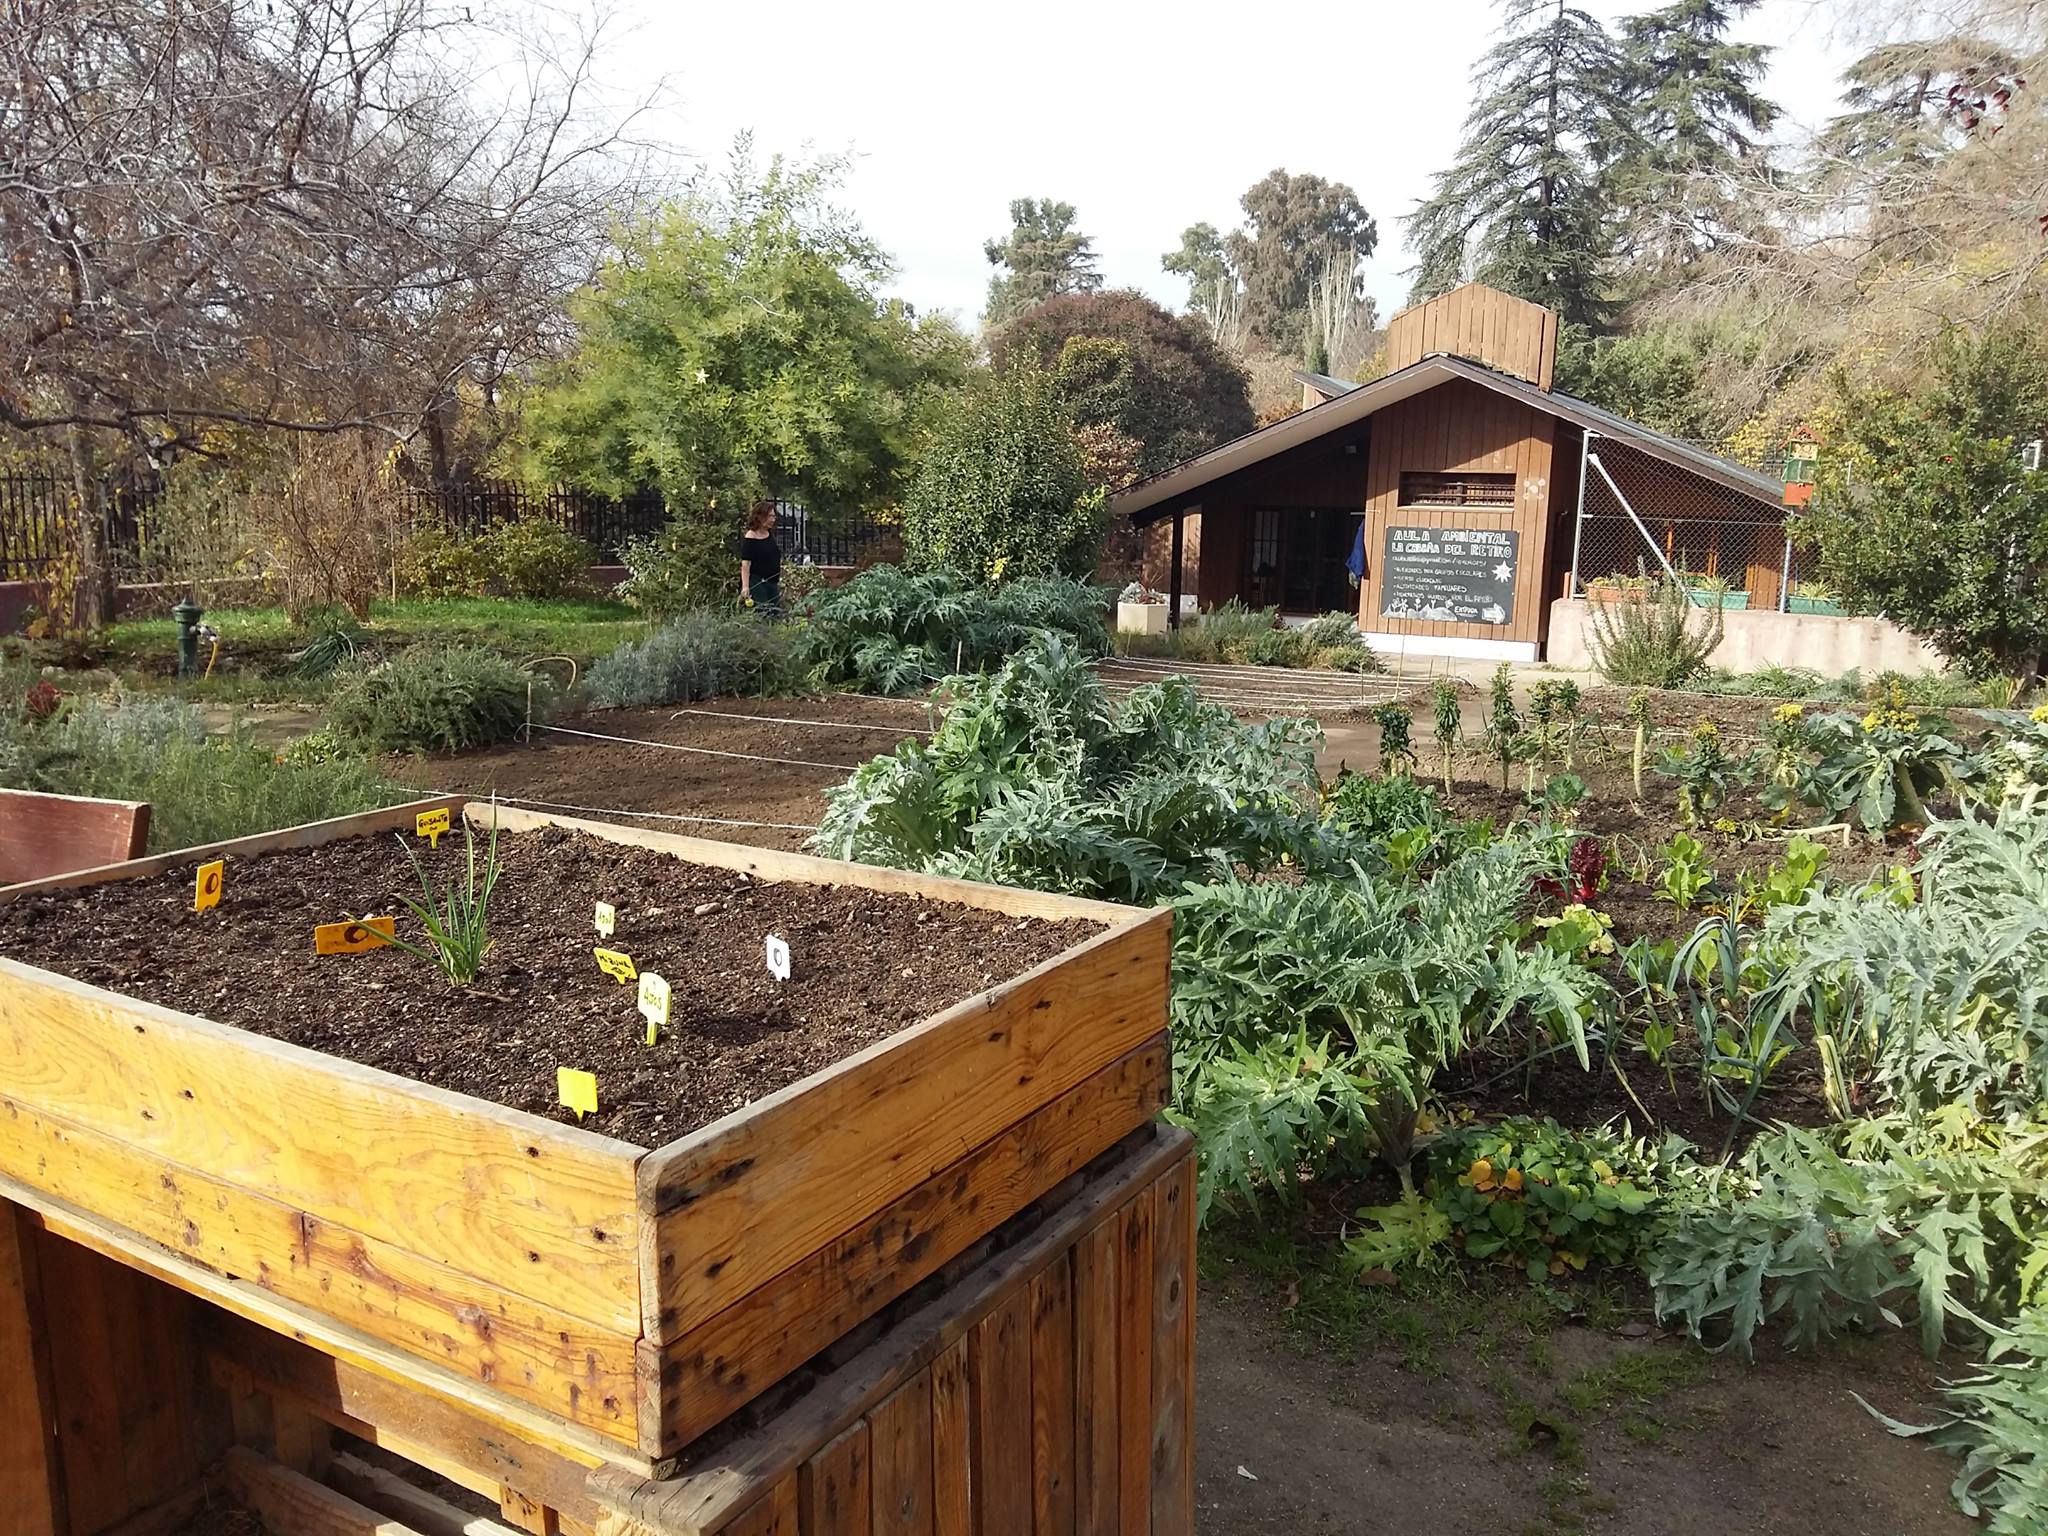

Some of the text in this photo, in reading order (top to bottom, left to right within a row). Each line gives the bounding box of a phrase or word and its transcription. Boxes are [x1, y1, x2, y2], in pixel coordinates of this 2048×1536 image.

[1393, 530, 1511, 545] AULA AMBIENTAL
[1391, 542, 1404, 553] LA
[1444, 544, 1466, 556] DEL
[1471, 544, 1513, 559] RETIRO
